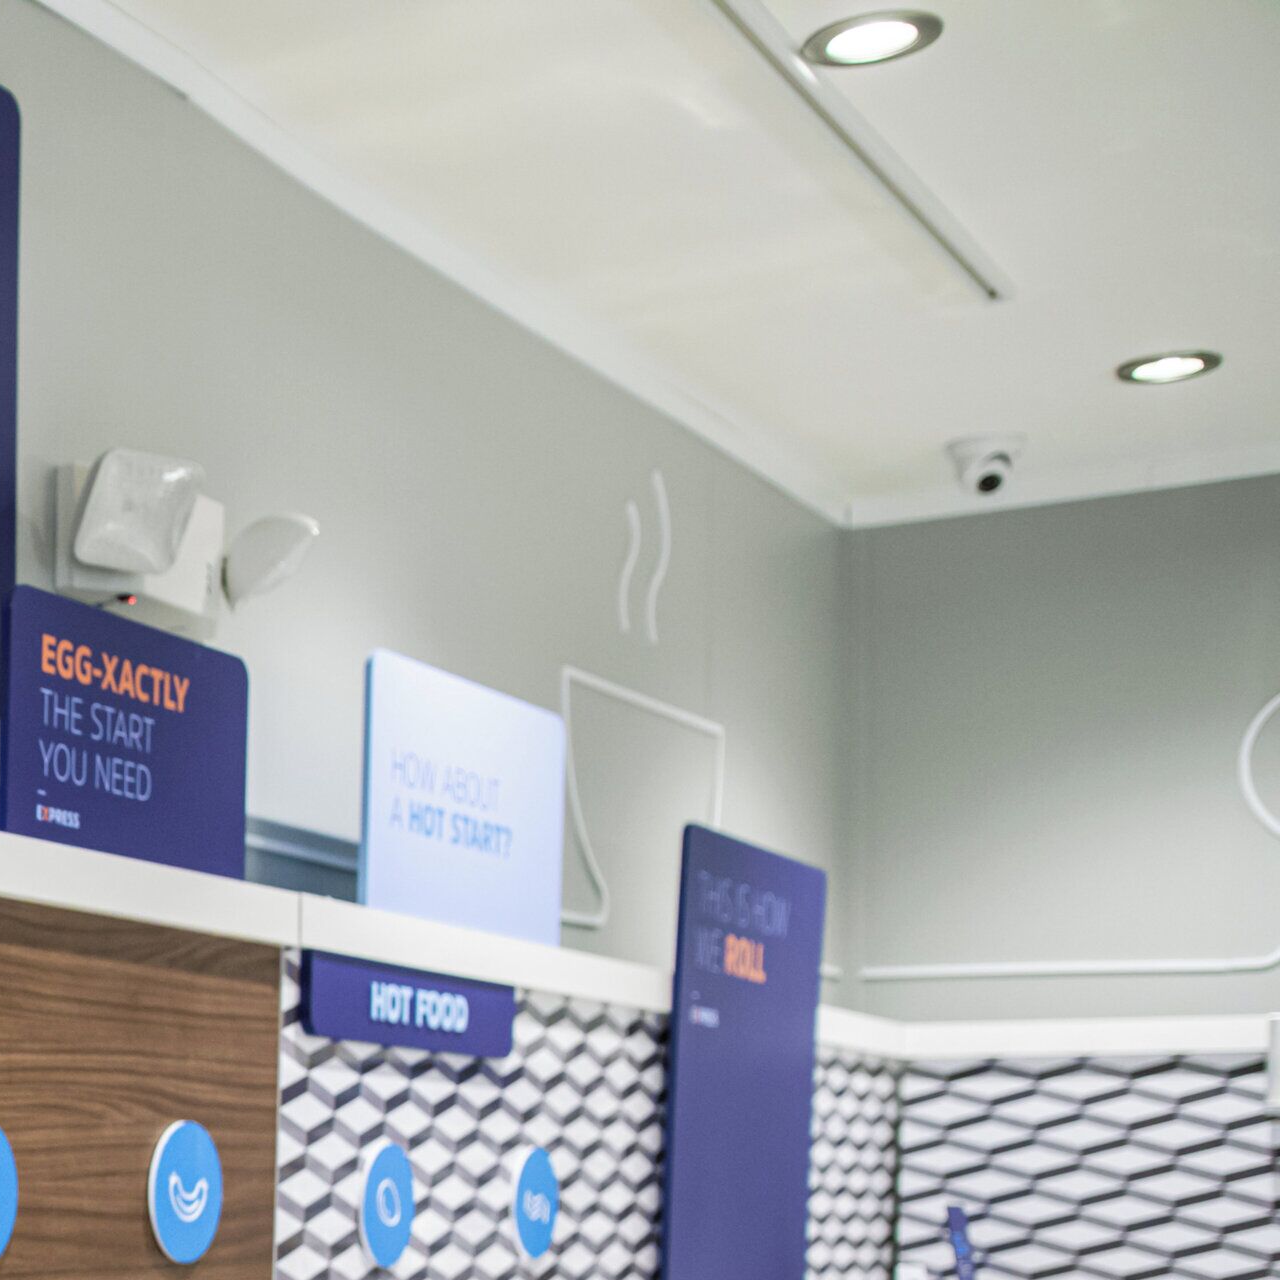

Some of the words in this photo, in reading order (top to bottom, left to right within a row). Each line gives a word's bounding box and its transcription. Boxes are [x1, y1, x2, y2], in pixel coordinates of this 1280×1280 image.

[40, 633, 190, 713] EGG-XACTLY
[40, 687, 83, 737] THE
[90, 702, 156, 754] START
[38, 739, 87, 787] YOU
[94, 753, 153, 802] NEED
[36, 804, 81, 830] EXPRESS
[407, 800, 446, 843] HOT
[370, 980, 414, 1026] HOT
[415, 988, 470, 1034] FOOD
